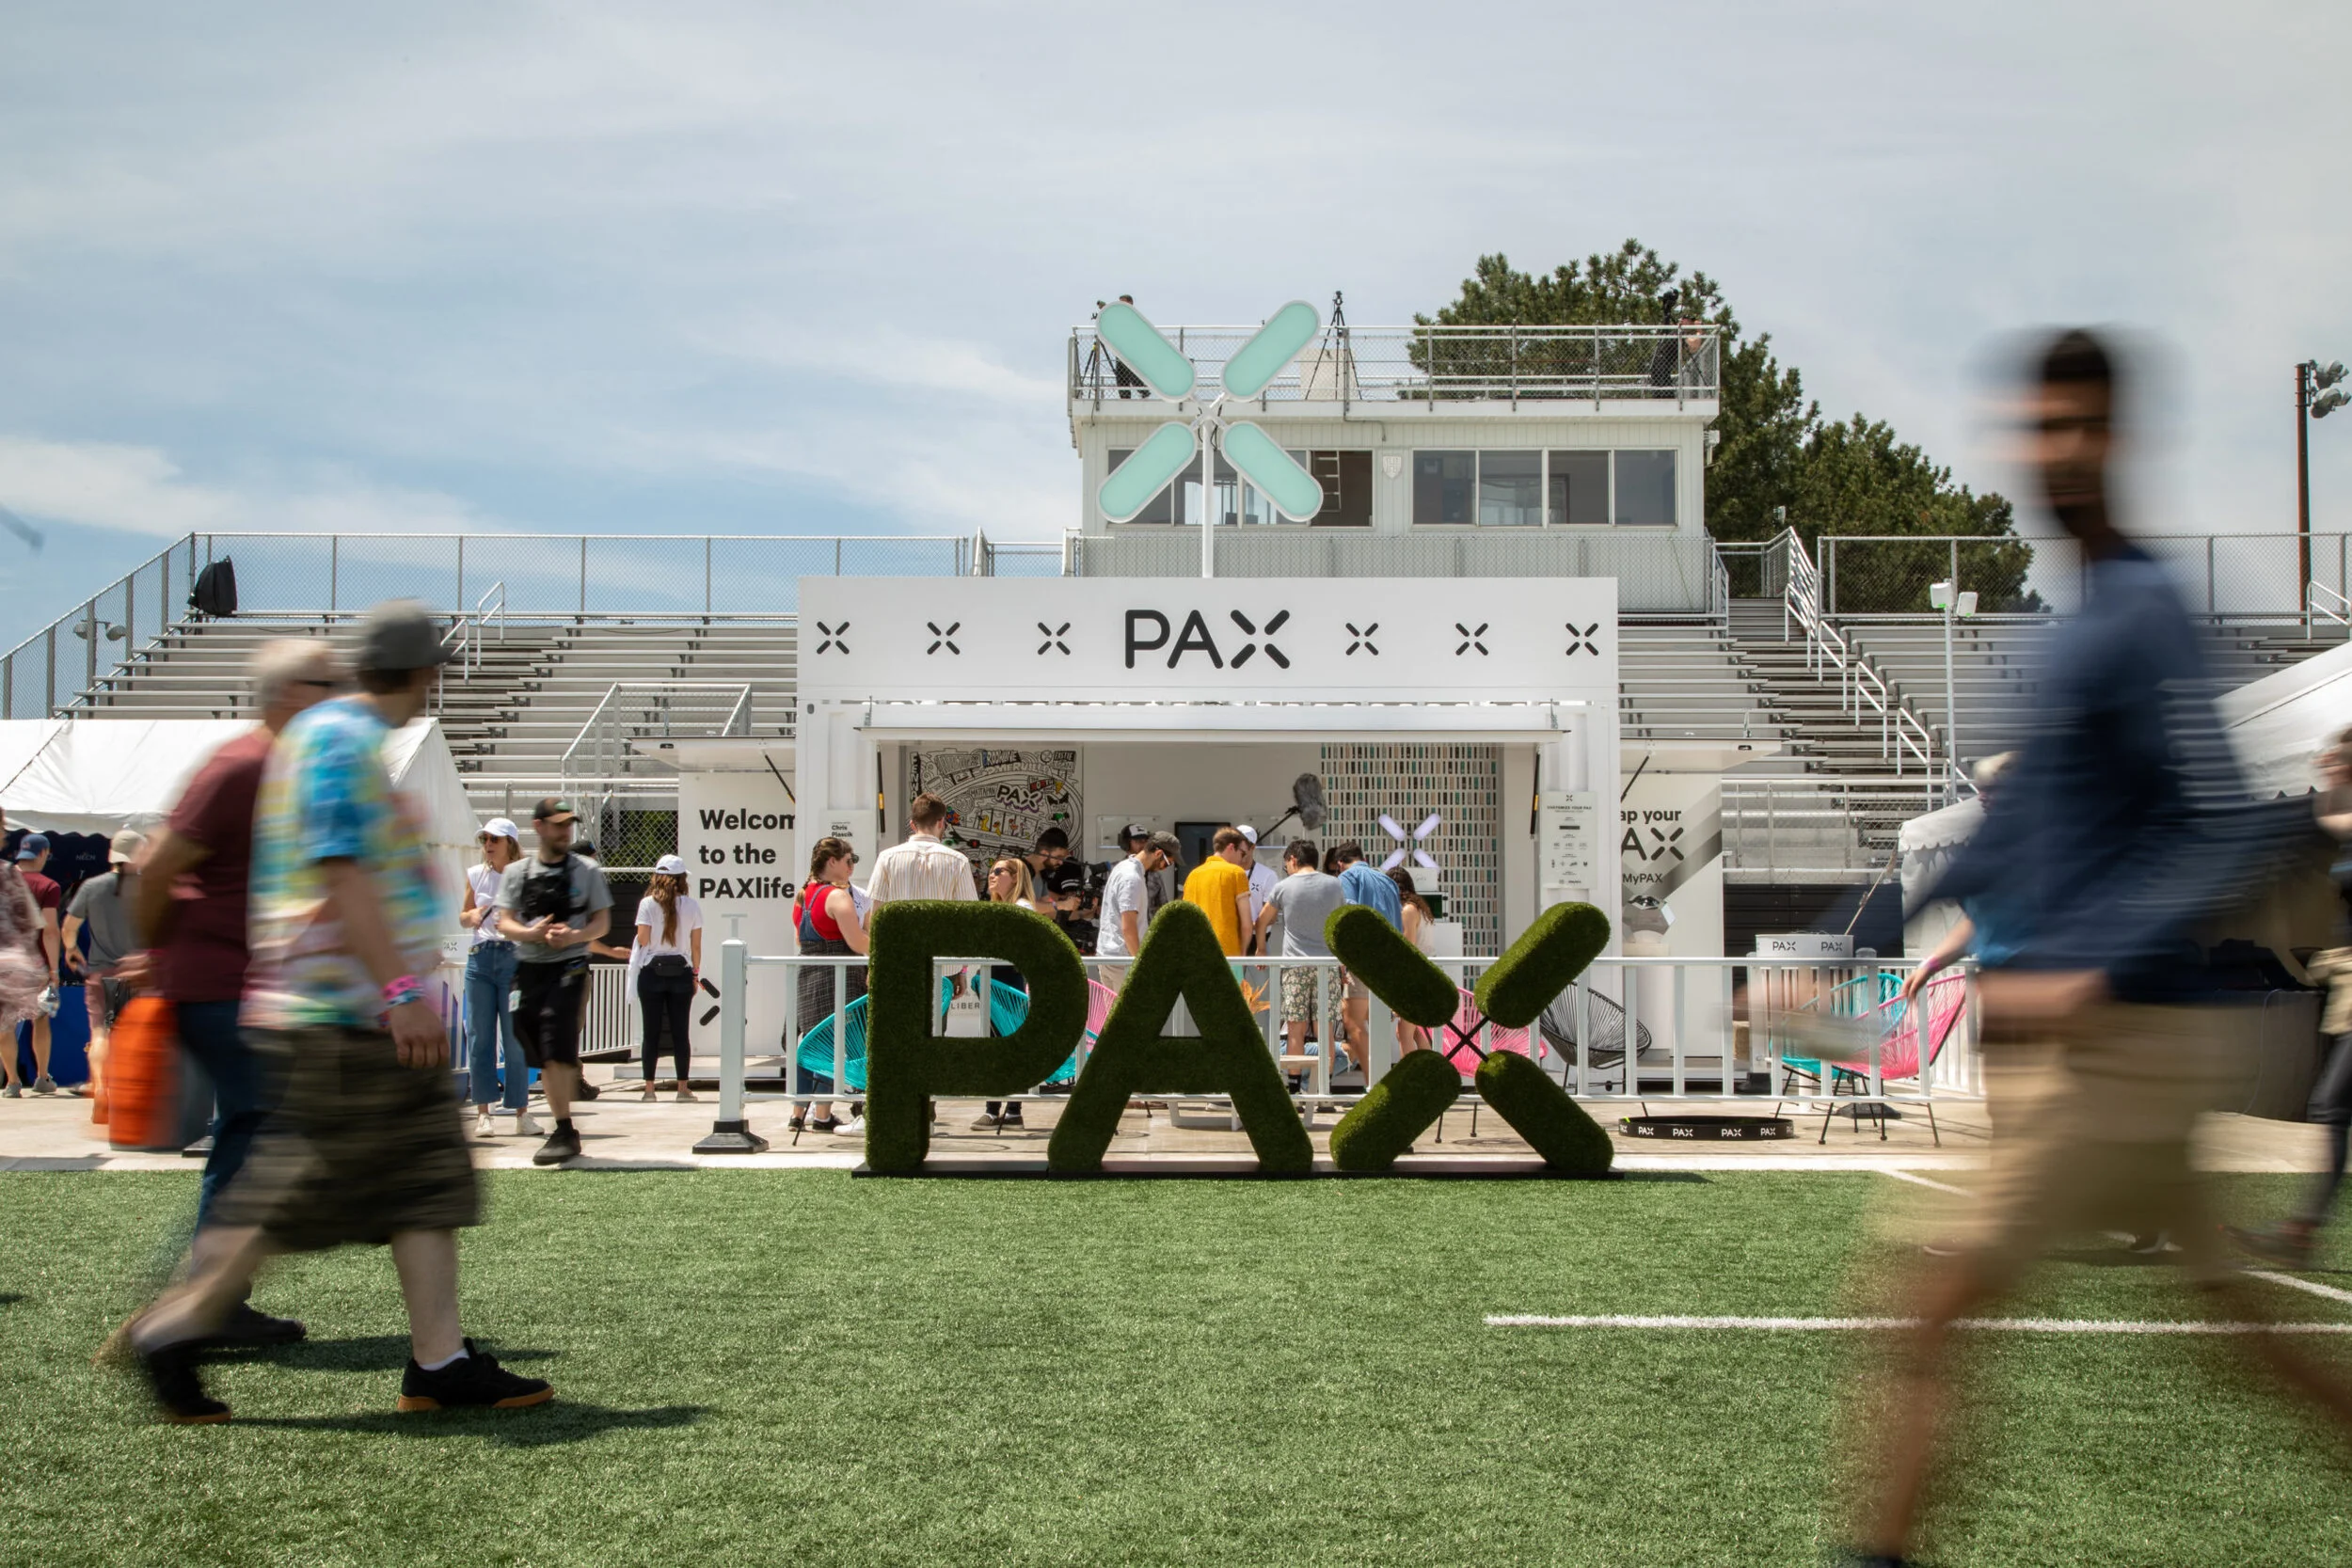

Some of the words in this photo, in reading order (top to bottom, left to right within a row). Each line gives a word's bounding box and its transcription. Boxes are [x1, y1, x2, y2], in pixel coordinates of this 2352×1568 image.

[1125, 610, 1290, 669] PAX
[910, 752, 919, 800] FENWA
[997, 784, 1041, 807] PAX
[699, 808, 795, 830] Welcom
[1620, 810, 1638, 825] ap
[1643, 810, 1681, 825] your
[699, 845, 725, 864] to
[733, 843, 776, 864] the
[1621, 827, 1684, 861] AX
[699, 877, 795, 899] PAXlife
[1772, 942, 1796, 951] PAX
[1820, 942, 1843, 951] PAX
[866, 900, 1613, 1171] PAX
[1638, 1126, 1654, 1136] PAX
[1673, 1128, 1693, 1137] PAX
[1721, 1128, 1741, 1137] PAX
[1760, 1127, 1776, 1136] PAX
